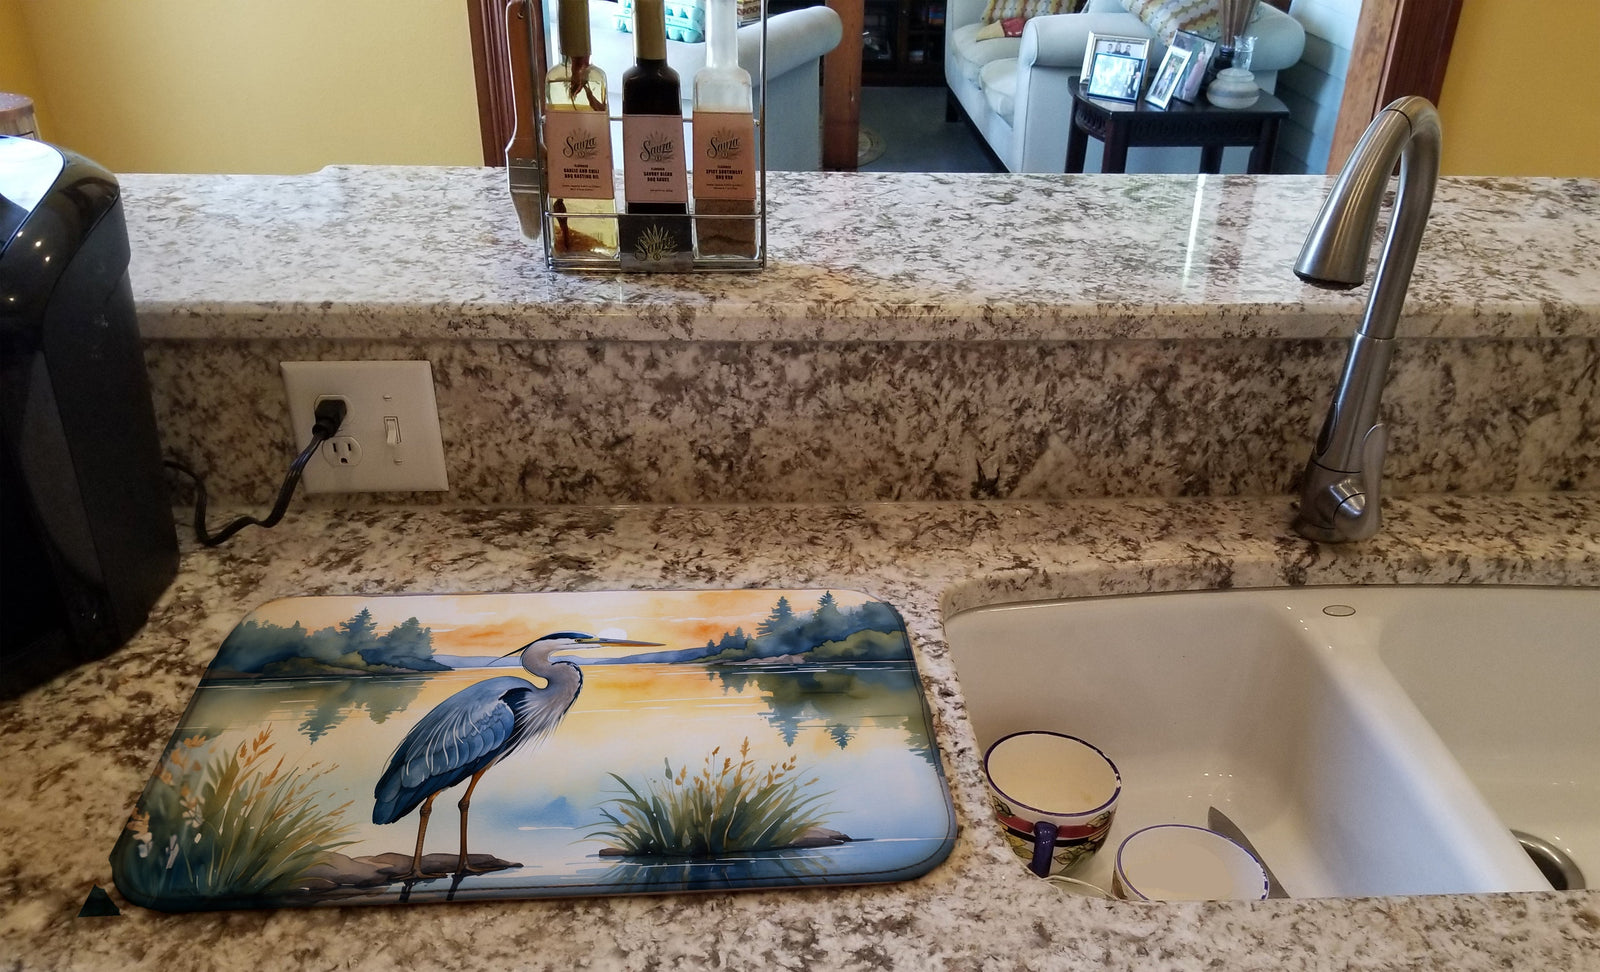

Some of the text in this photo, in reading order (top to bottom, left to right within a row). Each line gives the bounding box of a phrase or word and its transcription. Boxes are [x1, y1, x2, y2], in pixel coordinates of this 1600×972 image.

[563, 136, 597, 158] Sauza
[640, 140, 673, 162] Sauza
[706, 136, 739, 158] Sauza
